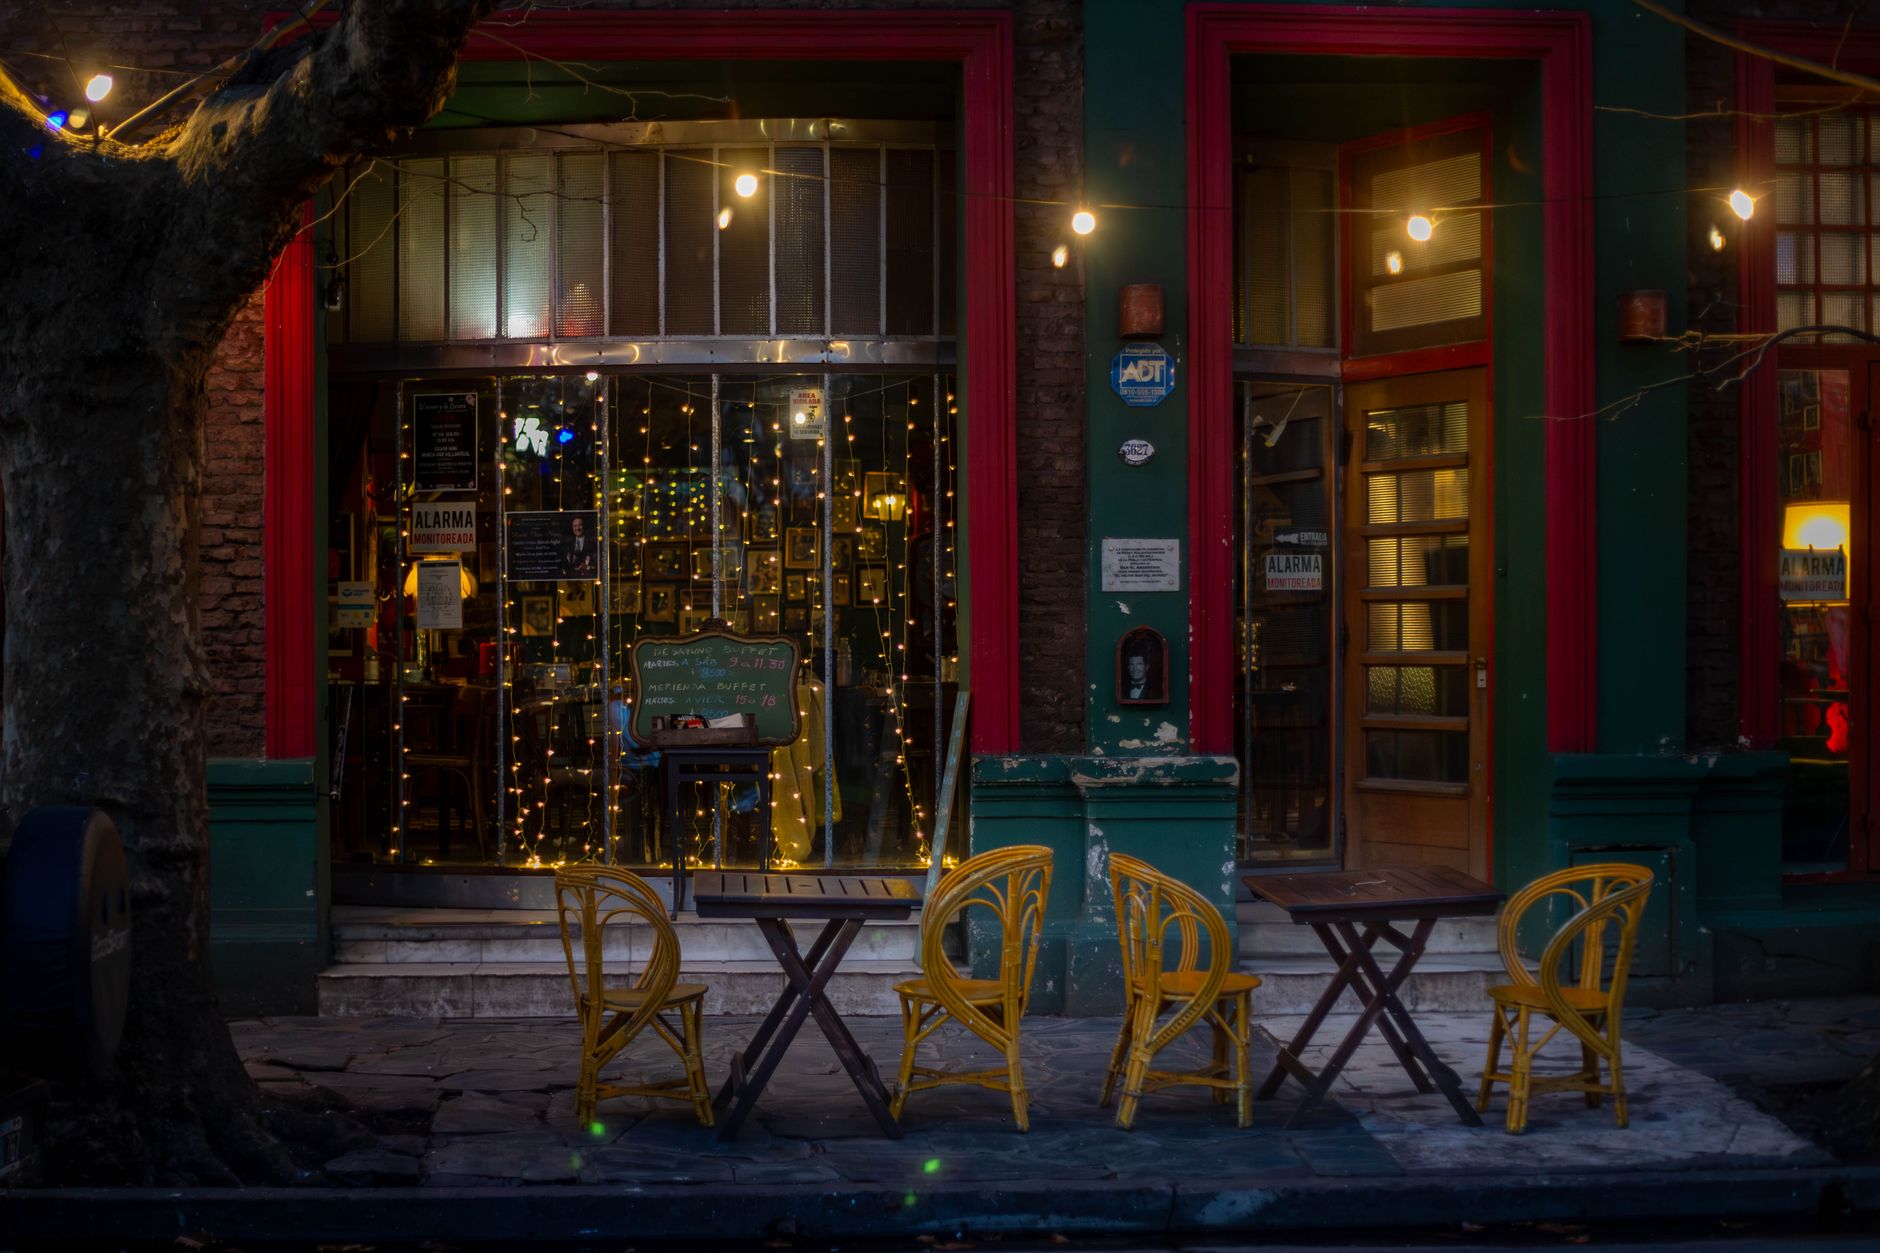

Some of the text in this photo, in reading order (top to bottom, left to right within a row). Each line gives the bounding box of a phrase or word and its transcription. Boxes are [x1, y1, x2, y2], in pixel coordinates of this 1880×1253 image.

[1121, 360, 1166, 383] ADT
[1124, 443, 1149, 456] 3627
[415, 511, 473, 529] ALARMA
[413, 533, 474, 545] MONITOREADA
[1268, 556, 1321, 573] ALARMA
[1781, 556, 1844, 576] ALARMA
[1268, 578, 1321, 589] MONITOREADA
[723, 645, 779, 656] BUFFET
[729, 655, 738, 667] 9
[648, 682, 767, 691] MERIENDA BUFFET
[760, 694, 777, 707] 18
